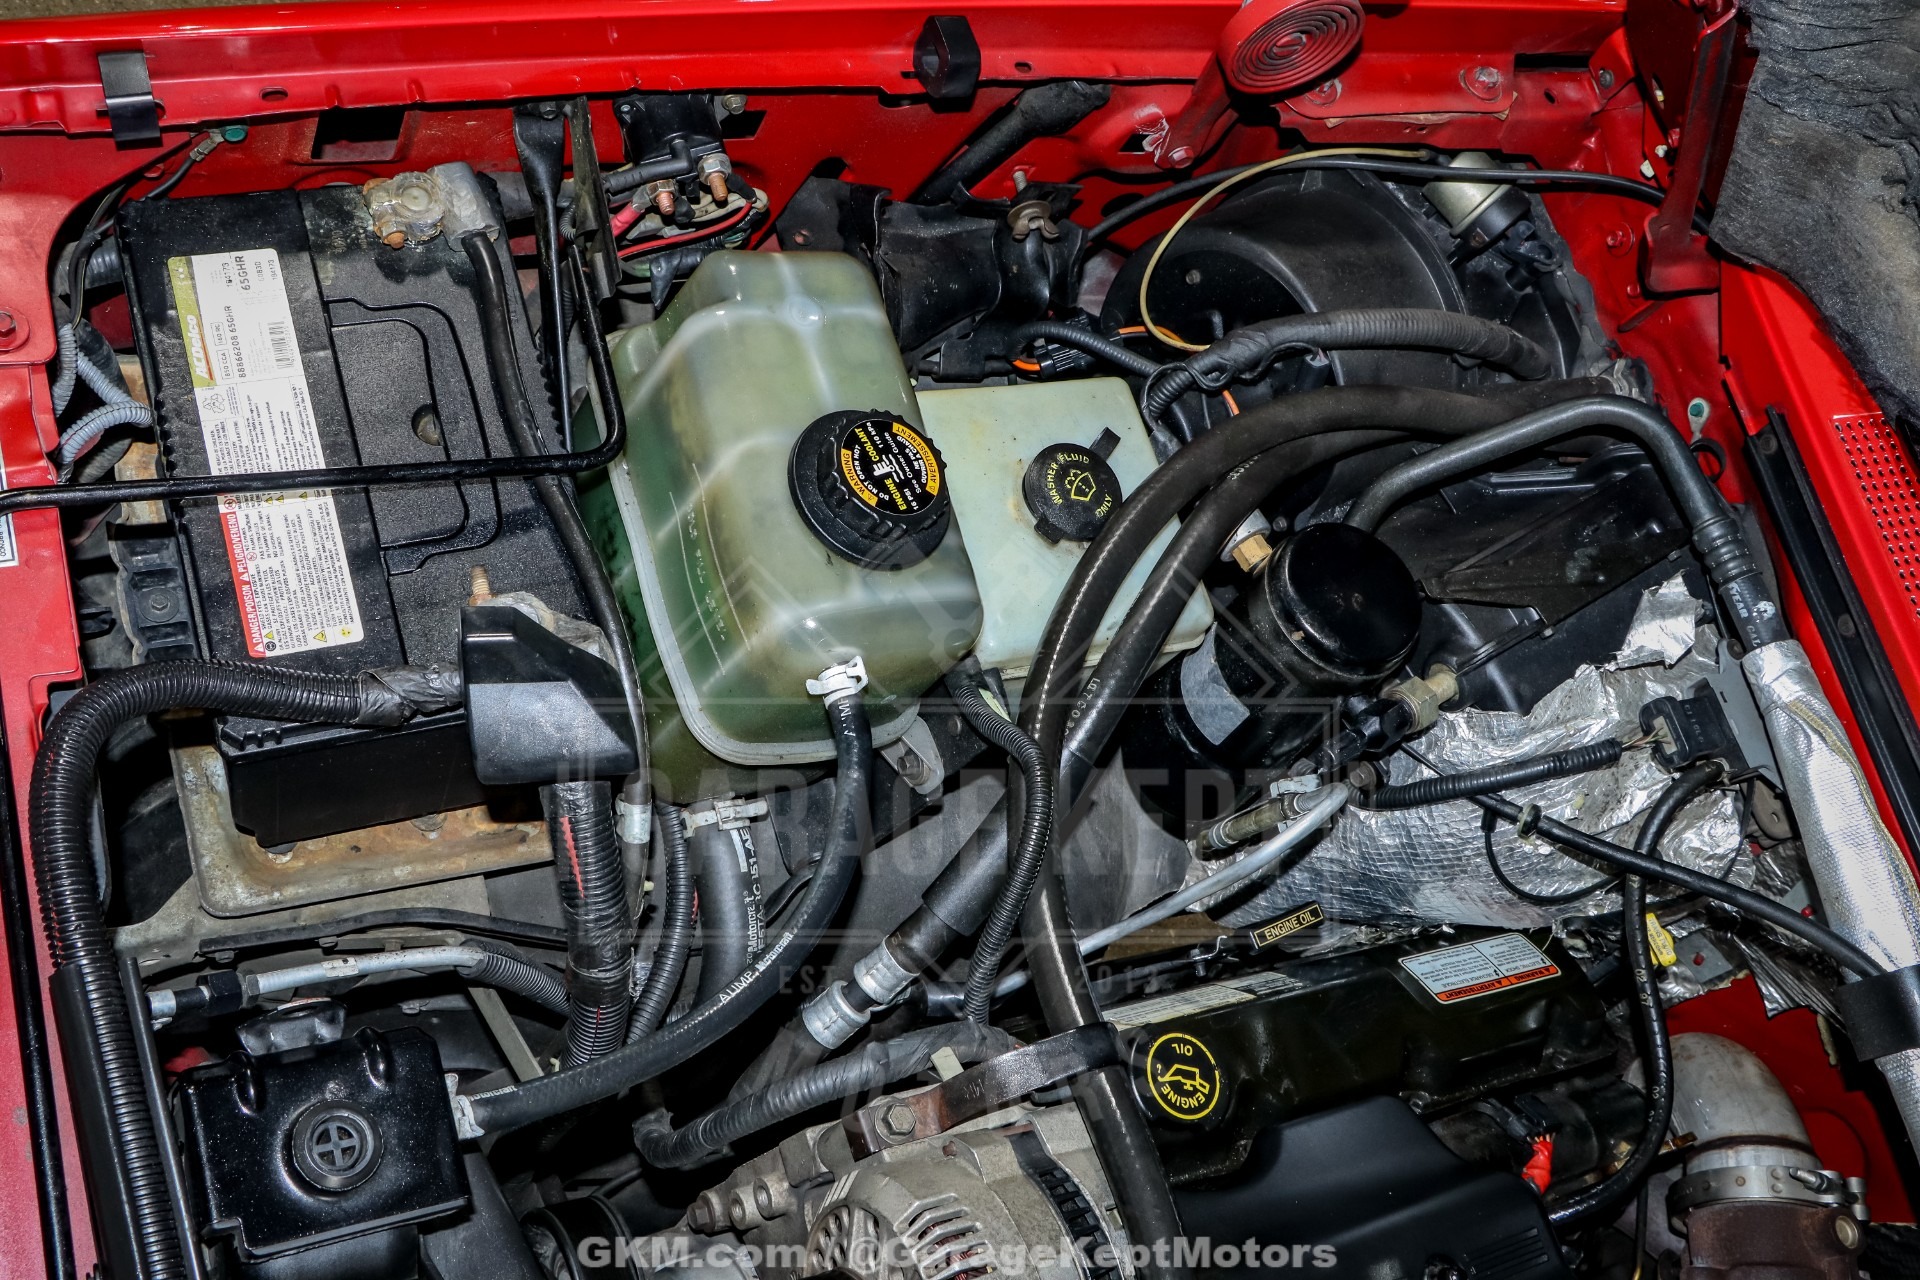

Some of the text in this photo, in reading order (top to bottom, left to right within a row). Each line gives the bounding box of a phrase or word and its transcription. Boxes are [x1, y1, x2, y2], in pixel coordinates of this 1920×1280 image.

[234, 256, 250, 290] 65GHR
[223, 305, 236, 332] 65GHR
[186, 314, 208, 378] ACDelco
[230, 336, 245, 377] 88866208
[896, 436, 917, 453] CHAUD
[897, 425, 937, 482] AVERTISSEMENT
[904, 448, 920, 469] NE PAS
[843, 451, 866, 494] WARNING
[853, 460, 864, 478] OPEN
[854, 427, 907, 510] ENGINE COOLANT
[866, 422, 918, 509] 16 PSI 110 kPa
[884, 431, 921, 492] See Owner Guide
[917, 459, 926, 482] OUVRIR
[863, 481, 878, 493] NOT
[1045, 452, 1088, 504] WASHER FLUID
[878, 492, 889, 500] DO
[1095, 494, 1112, 517] ONLY
[226, 514, 247, 571] PELIGRO/VENENO
[241, 585, 261, 642] DANGER/POISON
[1264, 911, 1315, 940] ENGINE OIL
[1513, 970, 1544, 981] WARNING
[1444, 982, 1495, 998] AVERTISSEMENT
[1171, 1043, 1192, 1056] OIL
[1160, 1083, 1205, 1108] ENGINE
